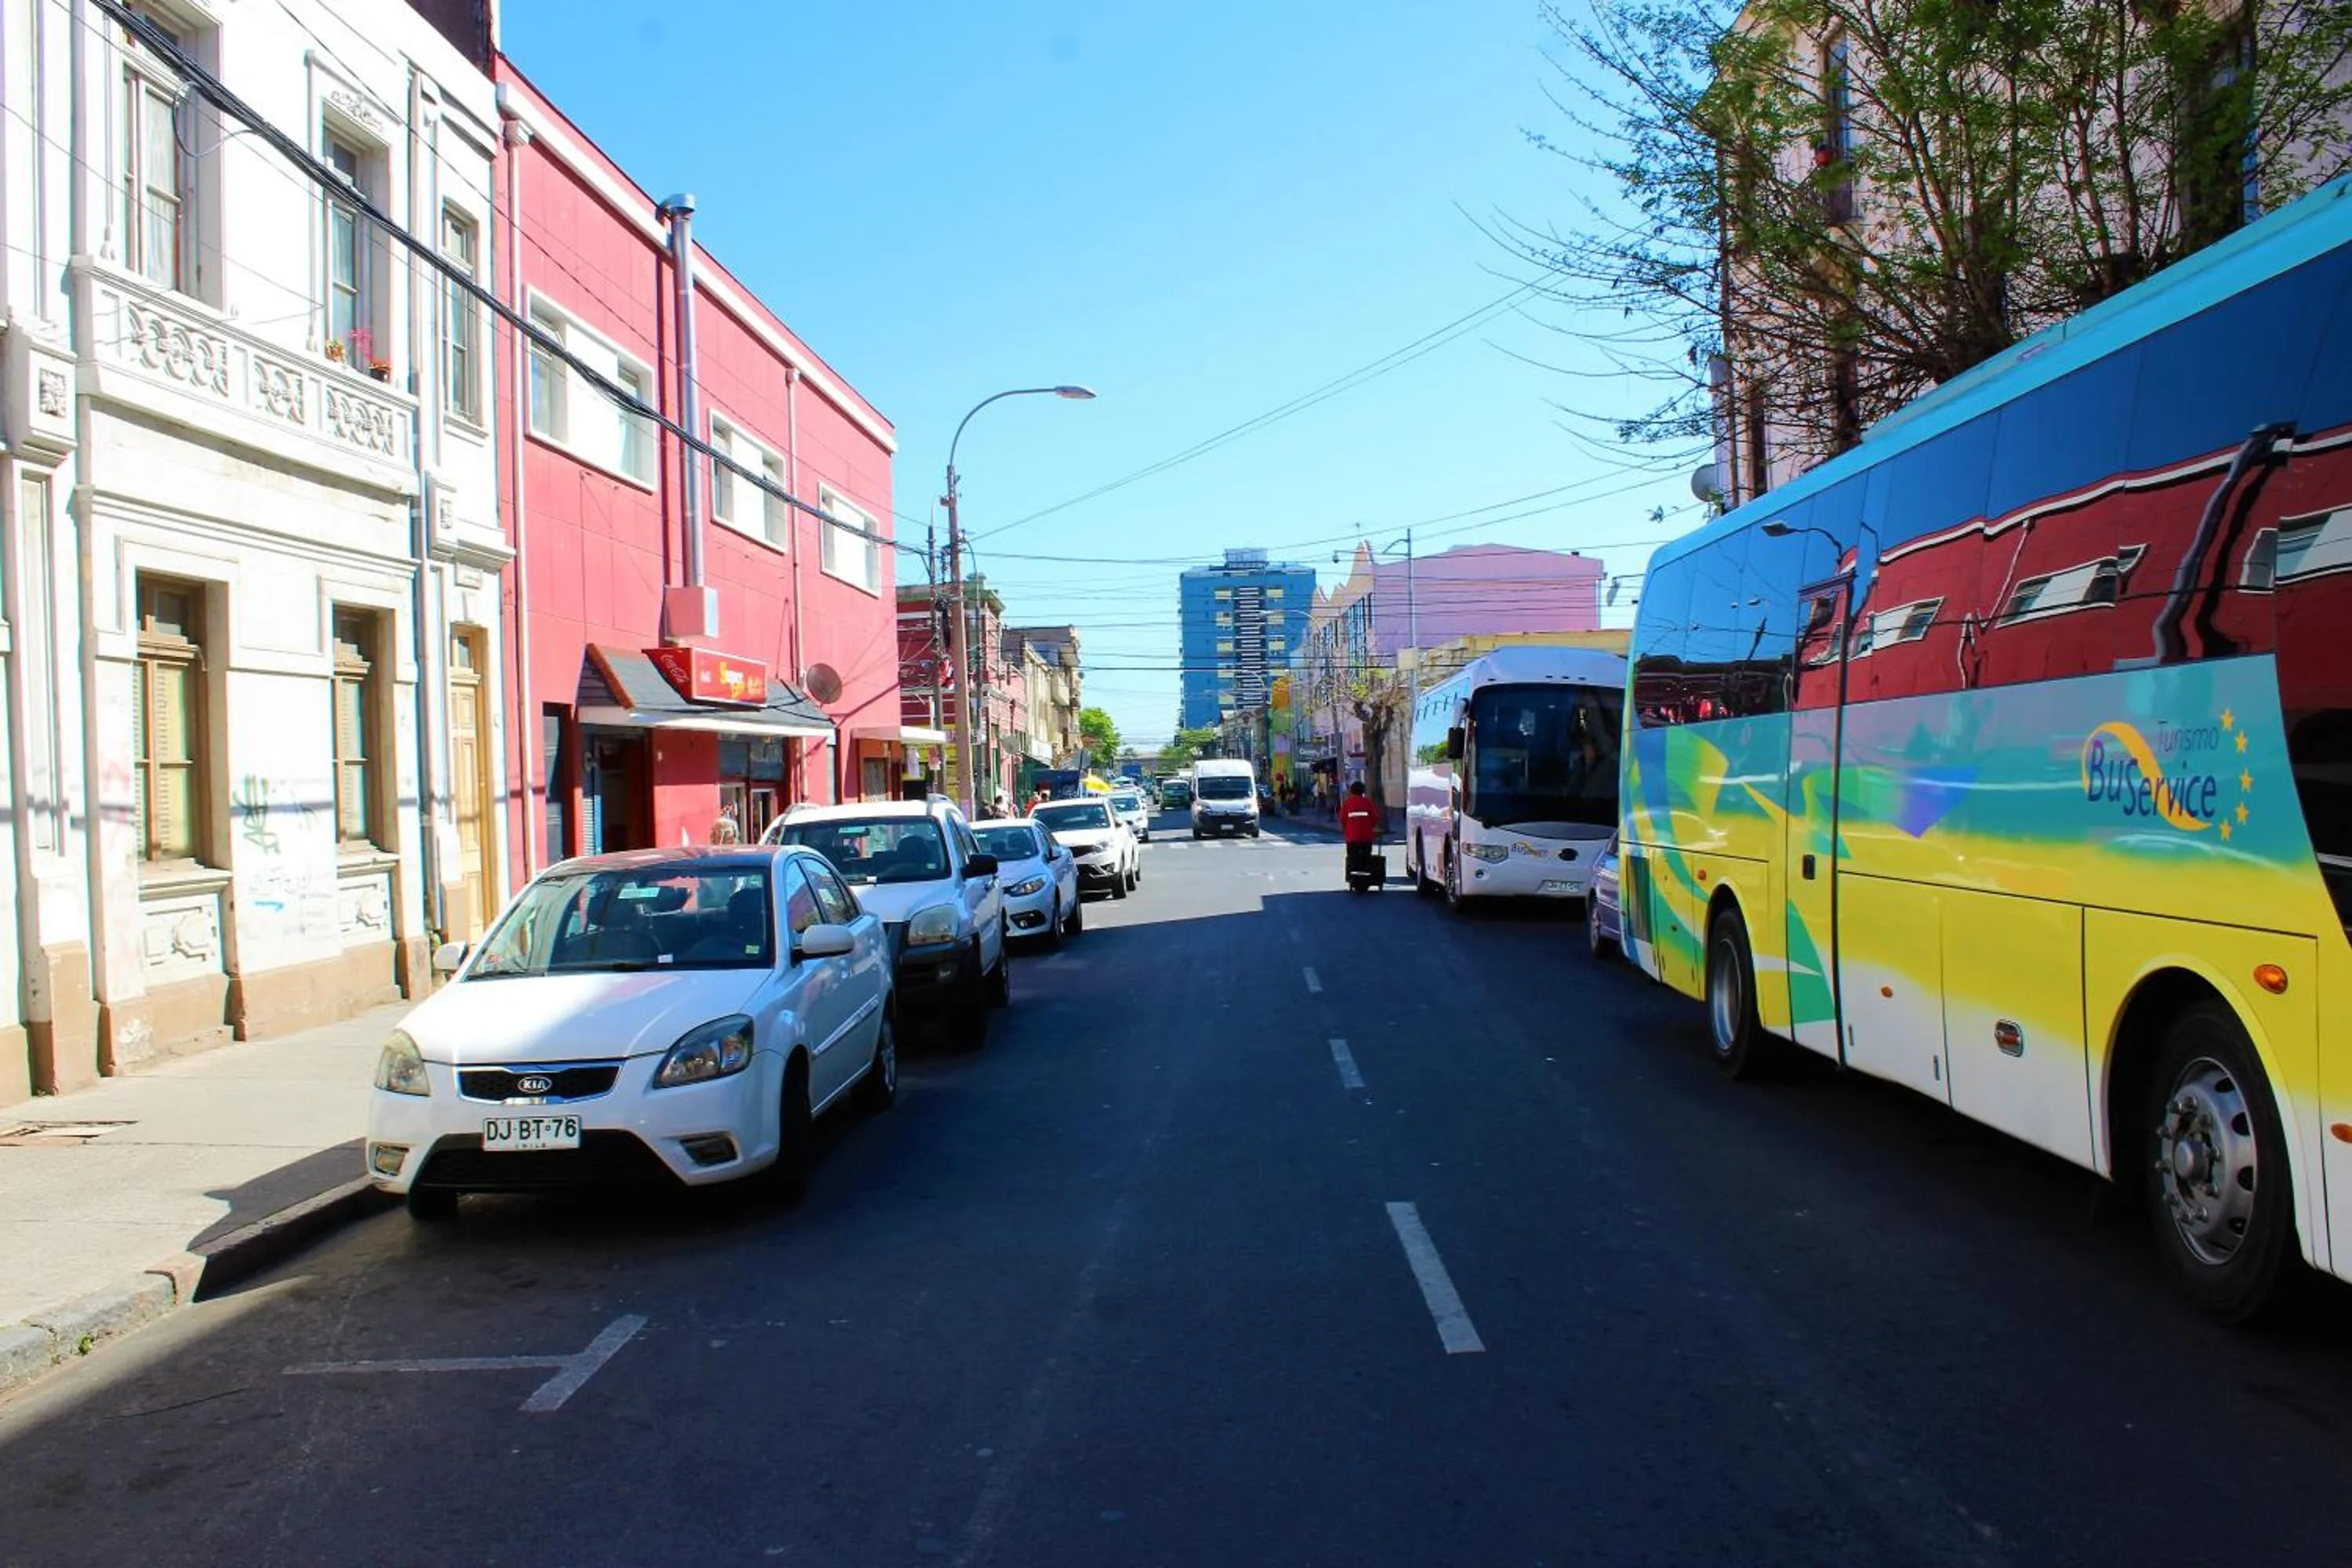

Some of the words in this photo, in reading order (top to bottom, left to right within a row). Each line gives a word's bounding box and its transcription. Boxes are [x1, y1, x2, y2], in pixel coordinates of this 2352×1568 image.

[2158, 720, 2220, 753] Turismo
[2088, 740, 2217, 818] BuService
[523, 1080, 546, 1090] KIA
